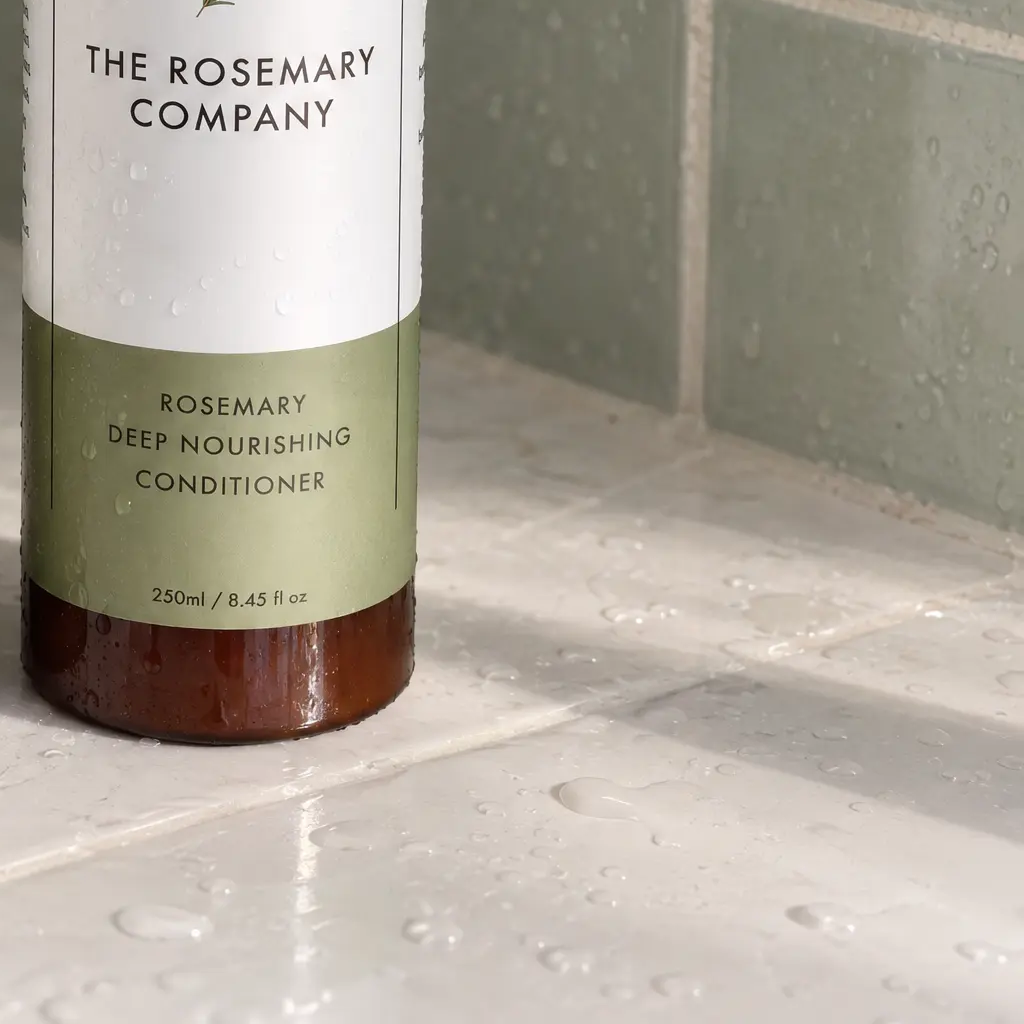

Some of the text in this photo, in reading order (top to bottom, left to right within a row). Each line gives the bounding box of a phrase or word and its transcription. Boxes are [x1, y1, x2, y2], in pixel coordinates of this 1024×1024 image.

[86, 45, 374, 87] THE ROSEMARY
[130, 98, 334, 132] COMPANY
[161, 393, 306, 416] ROSEMARY
[109, 424, 350, 455] DEEP NOURISHING
[136, 470, 324, 495] CONDITIONER
[152, 588, 307, 610] 250ml / 8.45 fl oz
